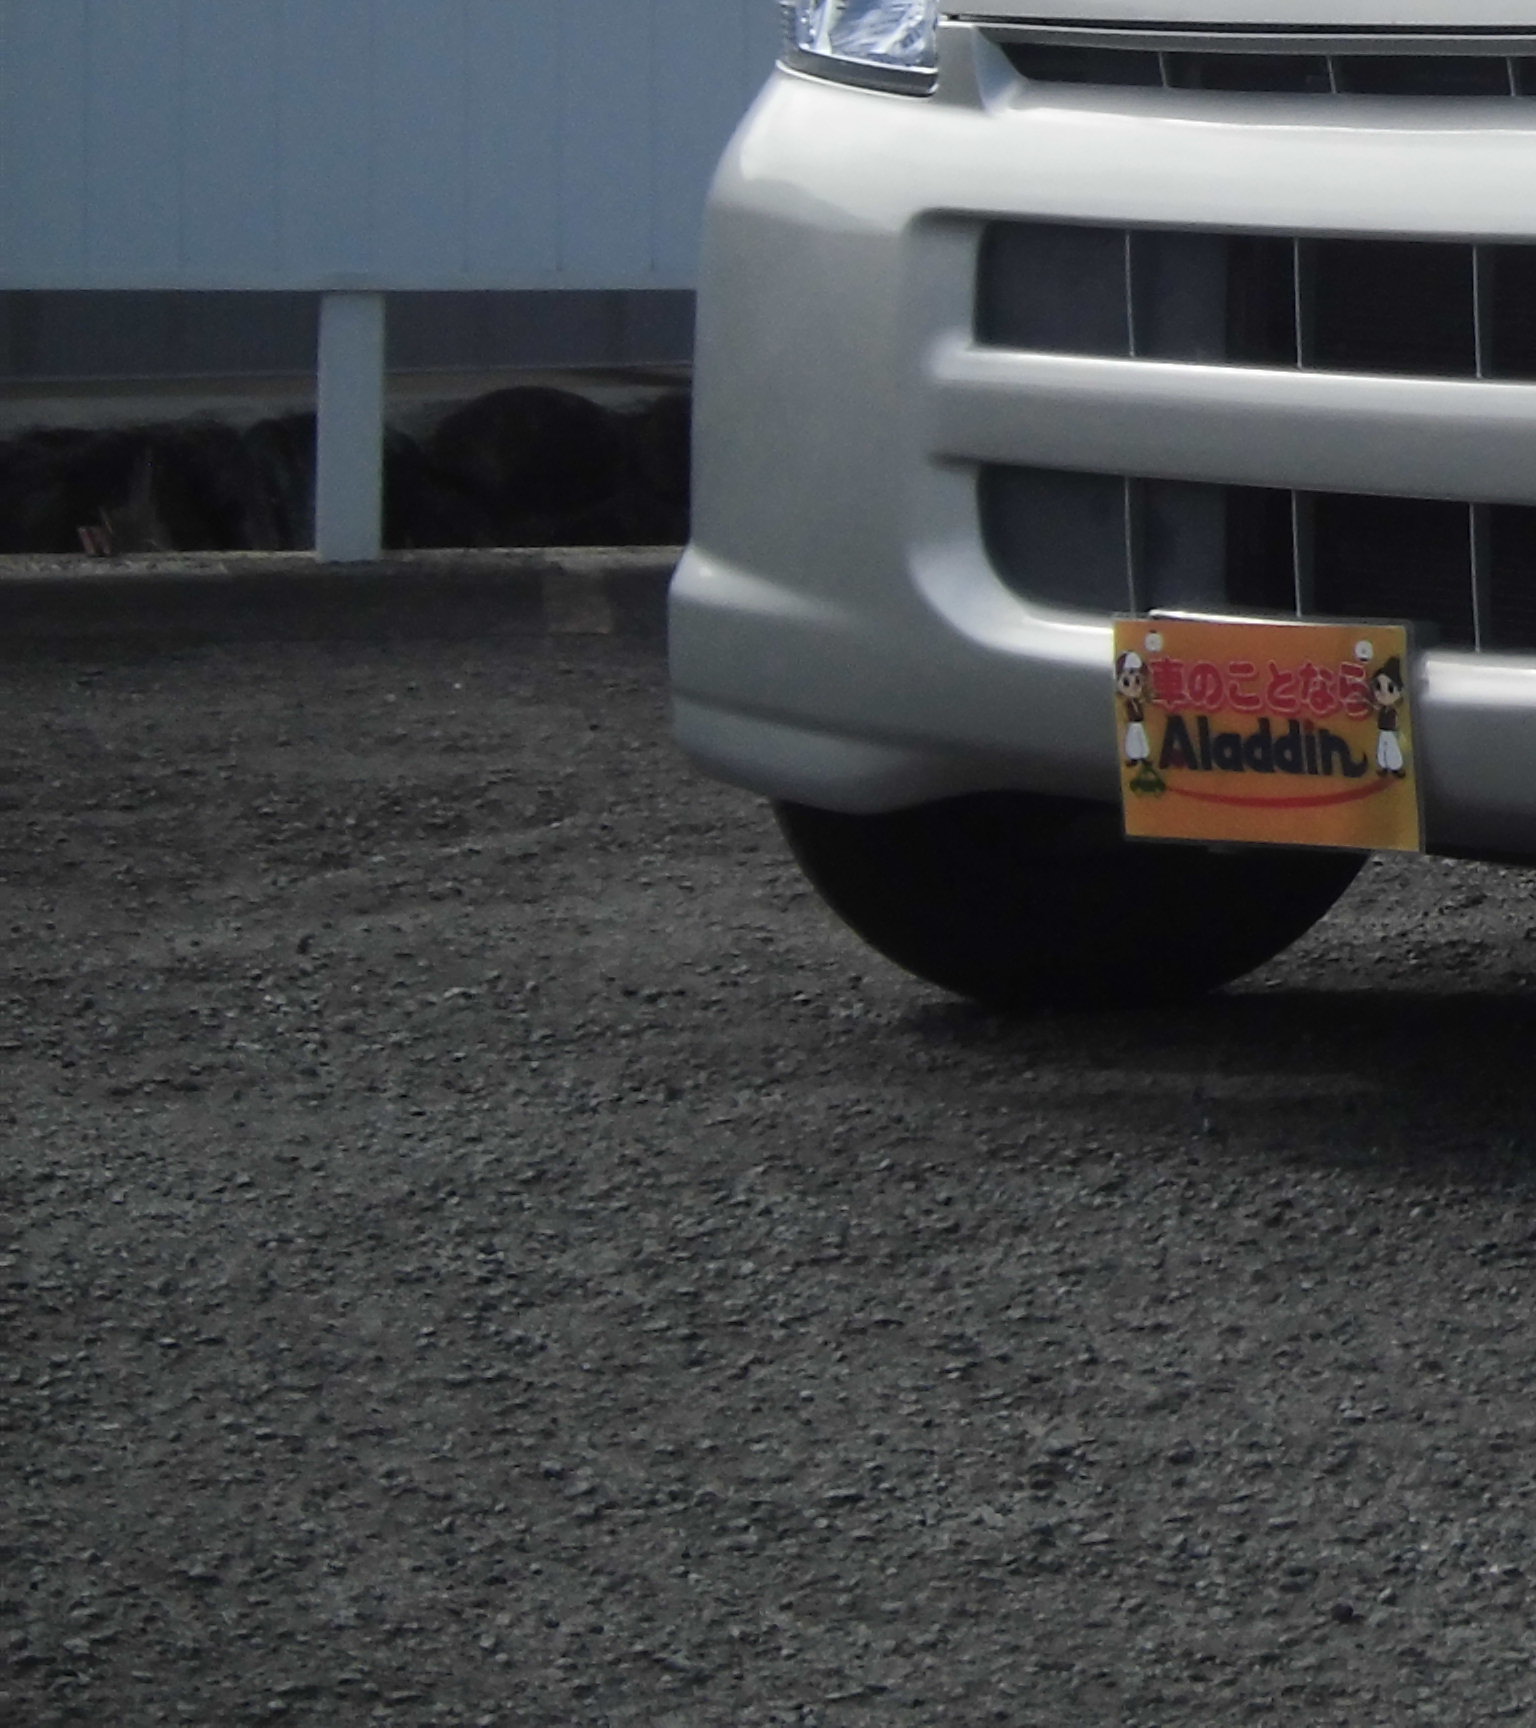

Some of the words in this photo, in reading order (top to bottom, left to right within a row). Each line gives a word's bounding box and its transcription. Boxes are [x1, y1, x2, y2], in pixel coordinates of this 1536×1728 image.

[1150, 657, 1376, 720] 車のことなら
[1158, 715, 1369, 778] Aladdin
